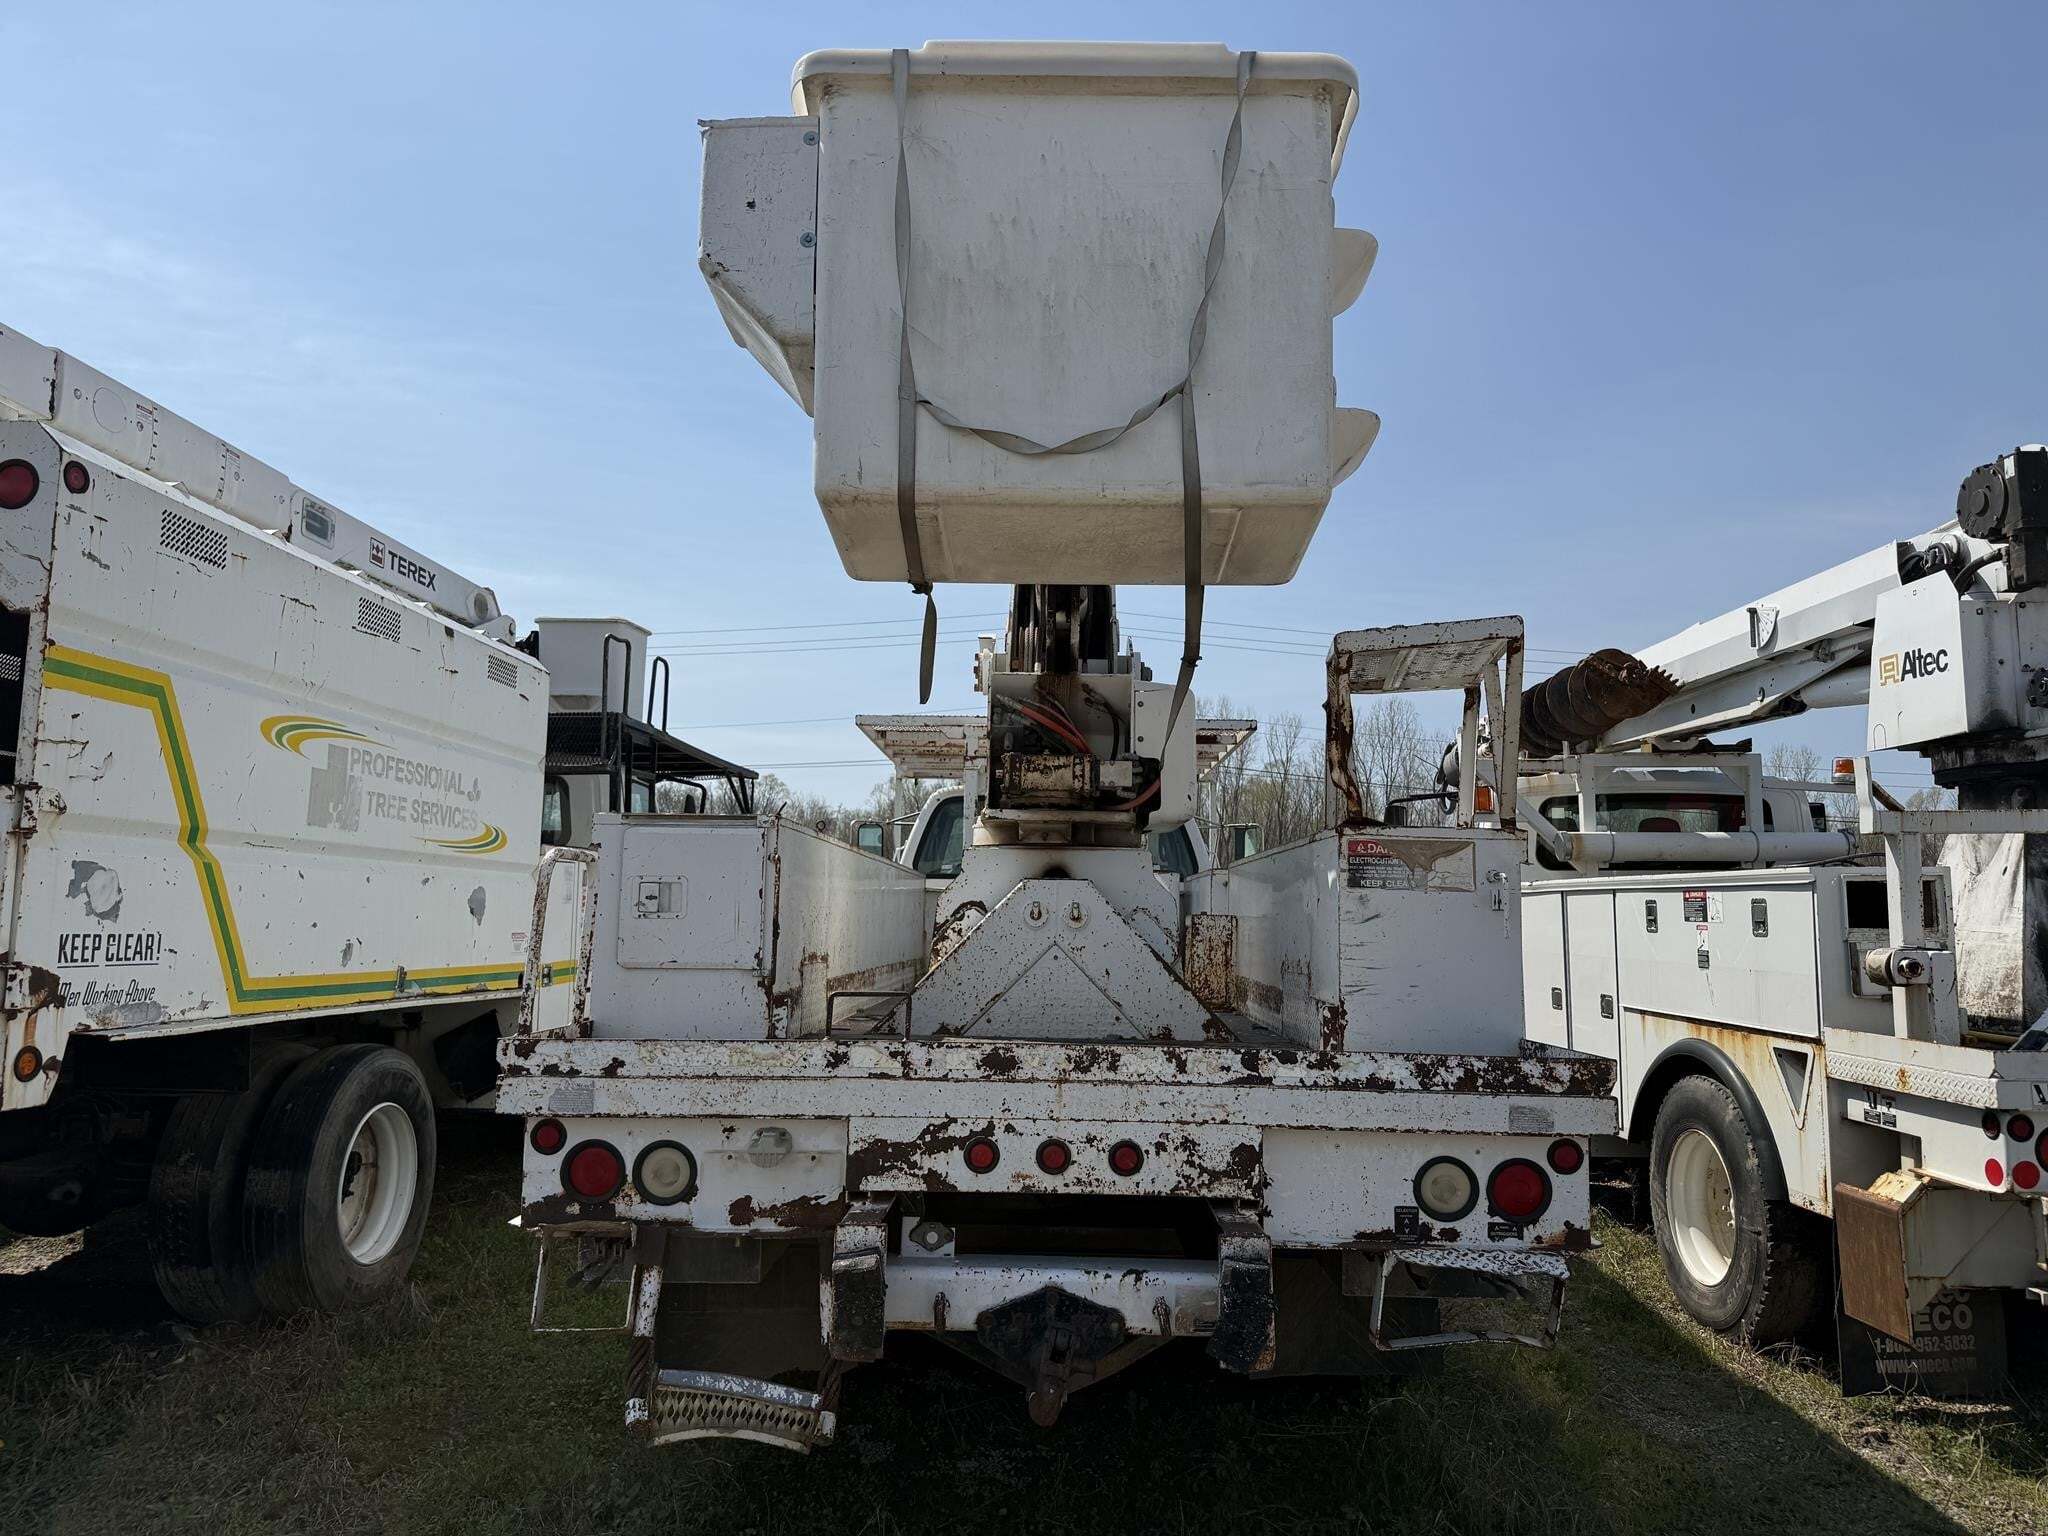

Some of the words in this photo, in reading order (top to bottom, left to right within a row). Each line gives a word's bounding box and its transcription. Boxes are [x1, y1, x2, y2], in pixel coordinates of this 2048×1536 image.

[387, 550, 436, 592] TEREX
[1900, 647, 1949, 682] Altec
[350, 748, 466, 796] PROFESSIONAL
[367, 791, 408, 822] TREE
[410, 800, 479, 831] SERVICES
[1349, 856, 1401, 865] ELECTROCUTION
[1360, 879, 1385, 888] KEEP
[57, 933, 102, 963] KEEP
[105, 931, 162, 962] CLEAR!
[81, 980, 124, 1006] Working
[124, 979, 156, 1003] Above
